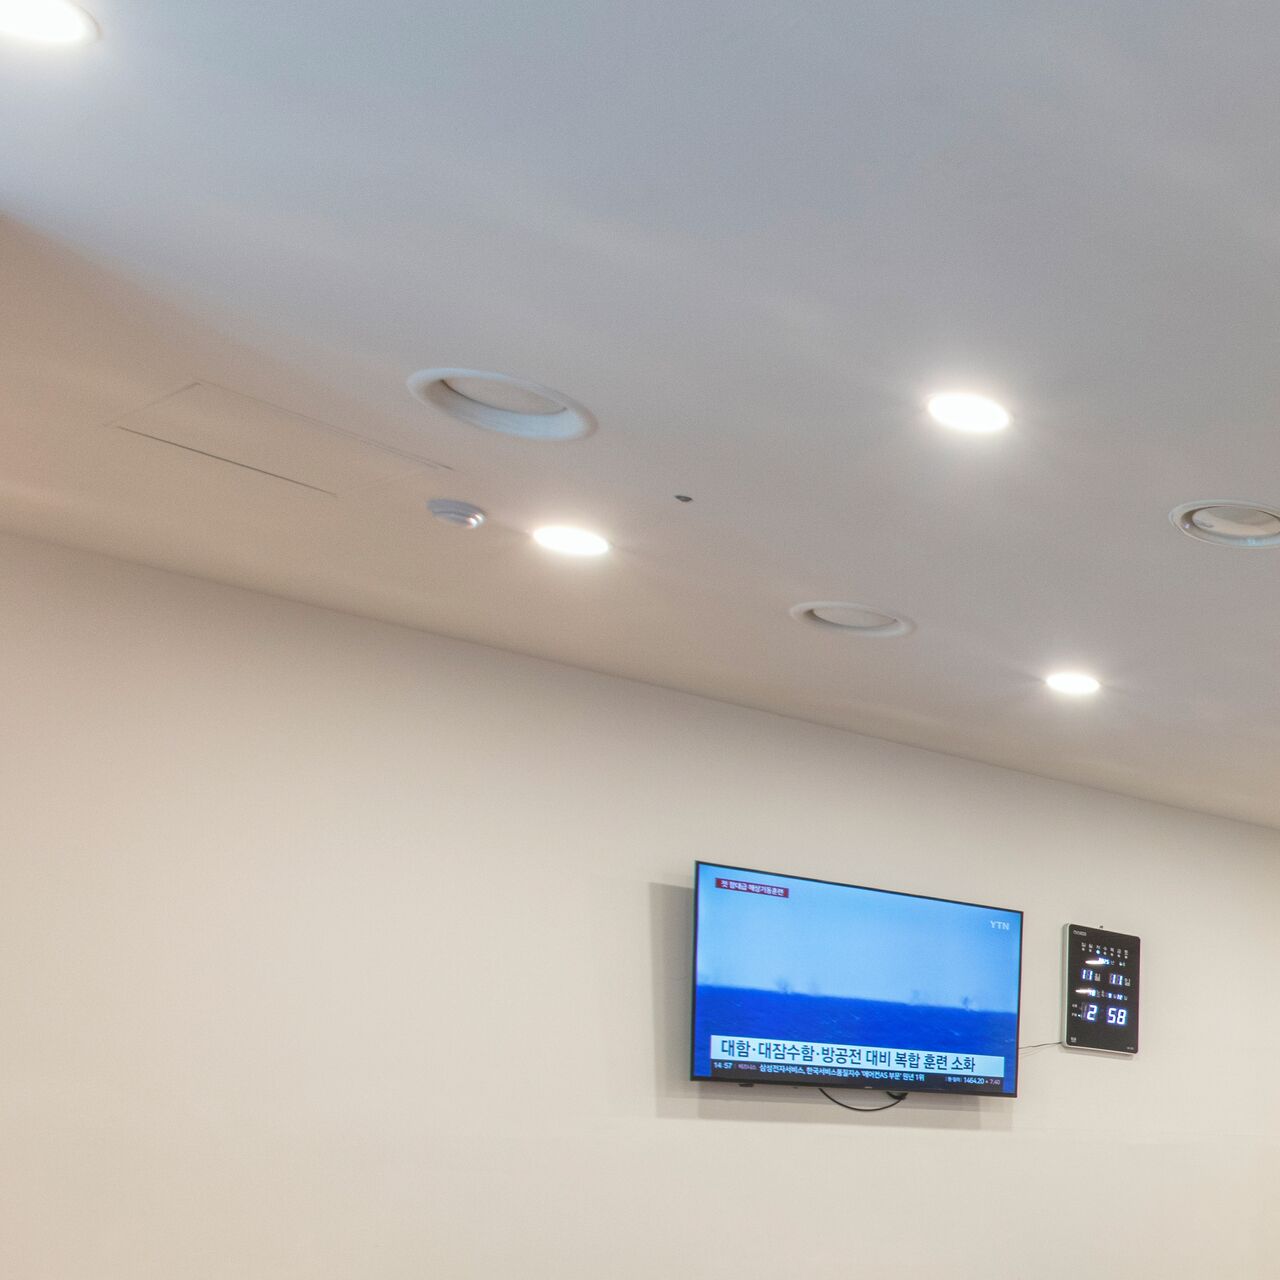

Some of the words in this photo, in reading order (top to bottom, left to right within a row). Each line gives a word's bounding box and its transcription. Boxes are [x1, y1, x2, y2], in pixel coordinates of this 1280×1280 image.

[990, 920, 1010, 930] YTN
[1107, 1007, 1127, 1025] 58
[721, 1039, 861, 1065] 대함·대잠수함·방공전
[866, 1049, 891, 1067] 대비
[895, 1051, 920, 1069] 복합
[923, 1053, 947, 1071] 훈련
[951, 1056, 975, 1073] 소화
